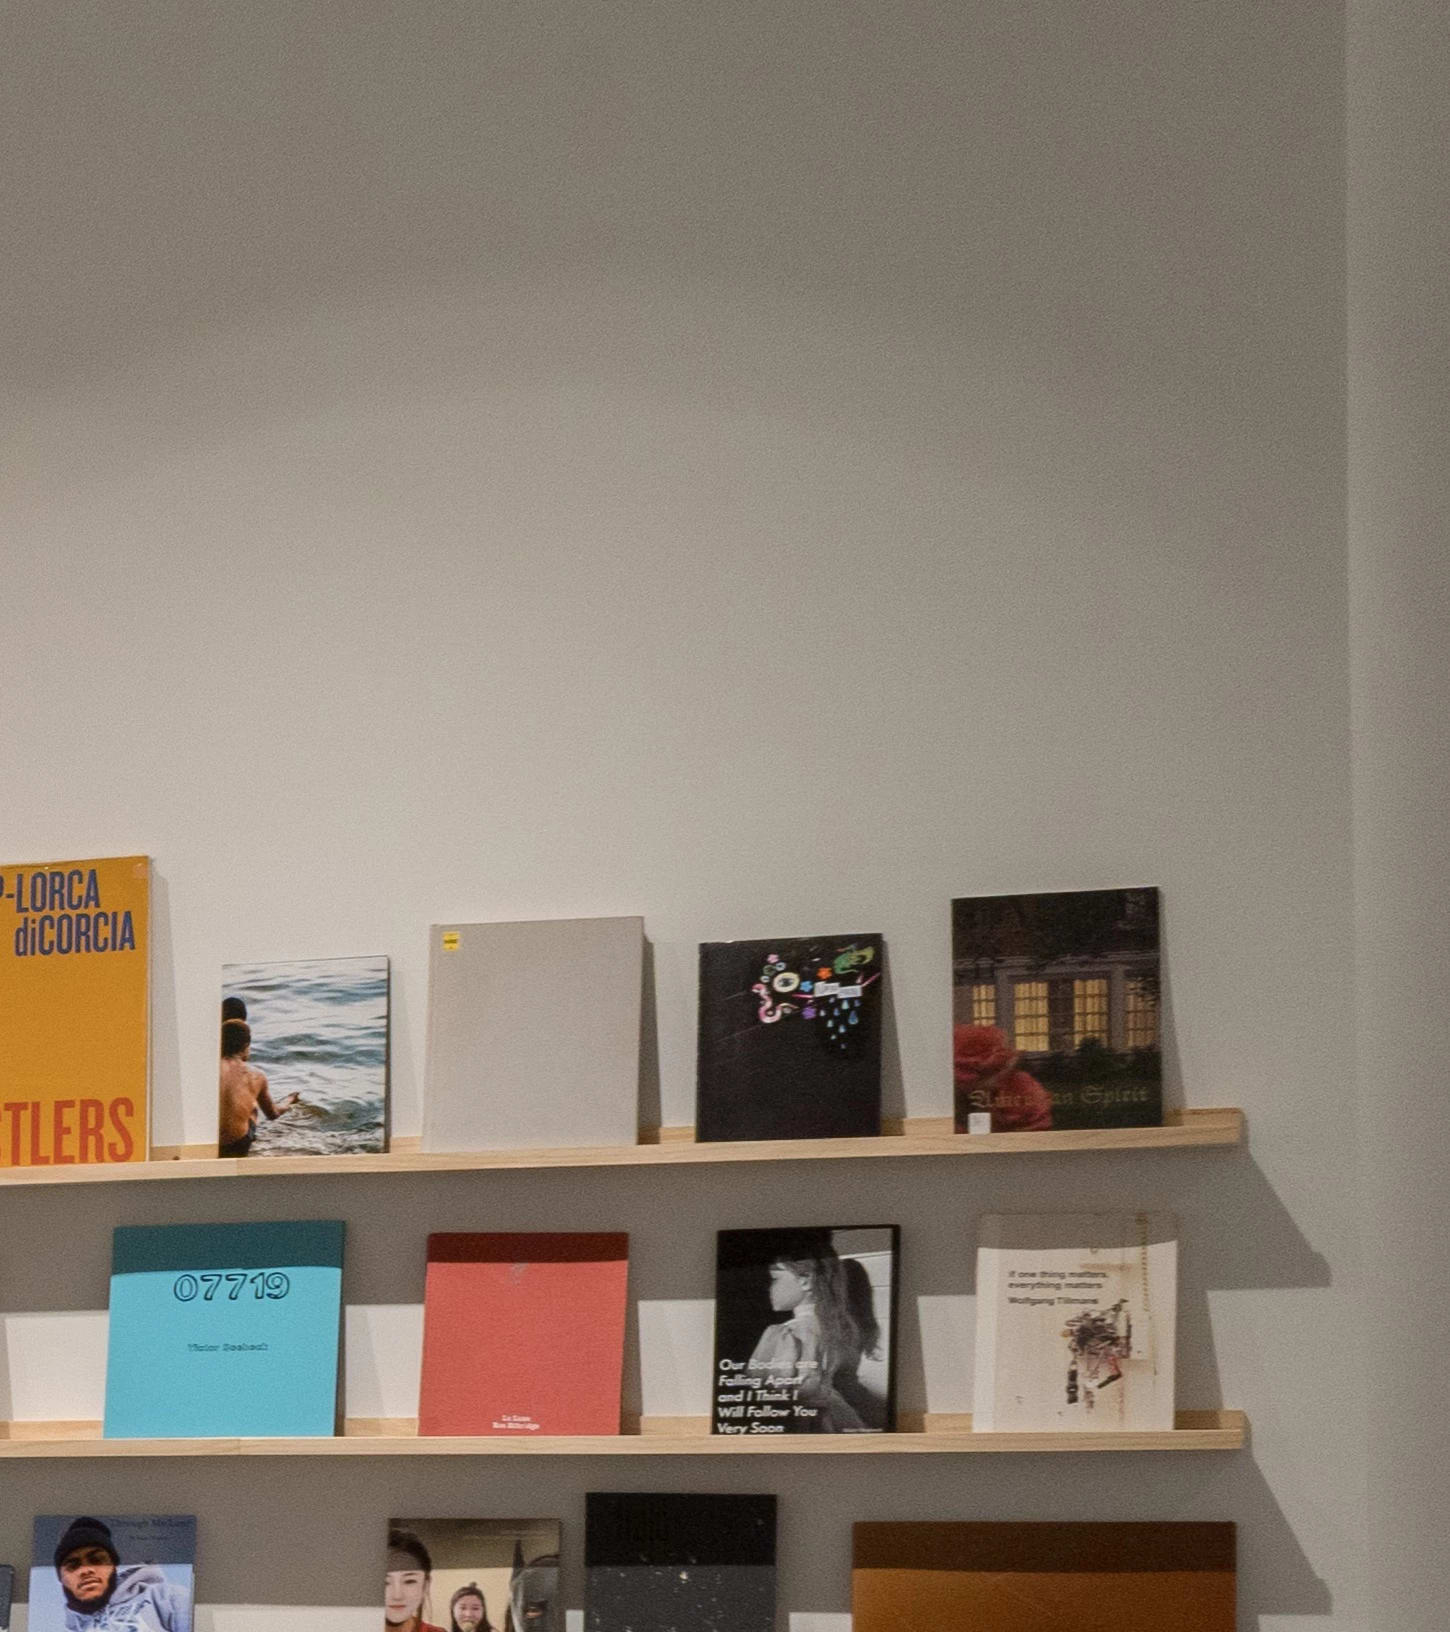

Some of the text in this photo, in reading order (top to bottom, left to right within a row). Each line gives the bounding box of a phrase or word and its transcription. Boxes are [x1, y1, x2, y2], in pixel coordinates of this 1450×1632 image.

[14, 910, 136, 957] diCORCIA
[173, 1272, 290, 1302] 07719
[719, 1358, 745, 1371] Our
[719, 1374, 805, 1388] Falling Apart
[717, 1390, 744, 1402] and
[747, 1389, 752, 1401] I
[756, 1389, 790, 1401] Think
[717, 1405, 819, 1418] Will Follow You
[717, 1421, 785, 1435] Very Soon
